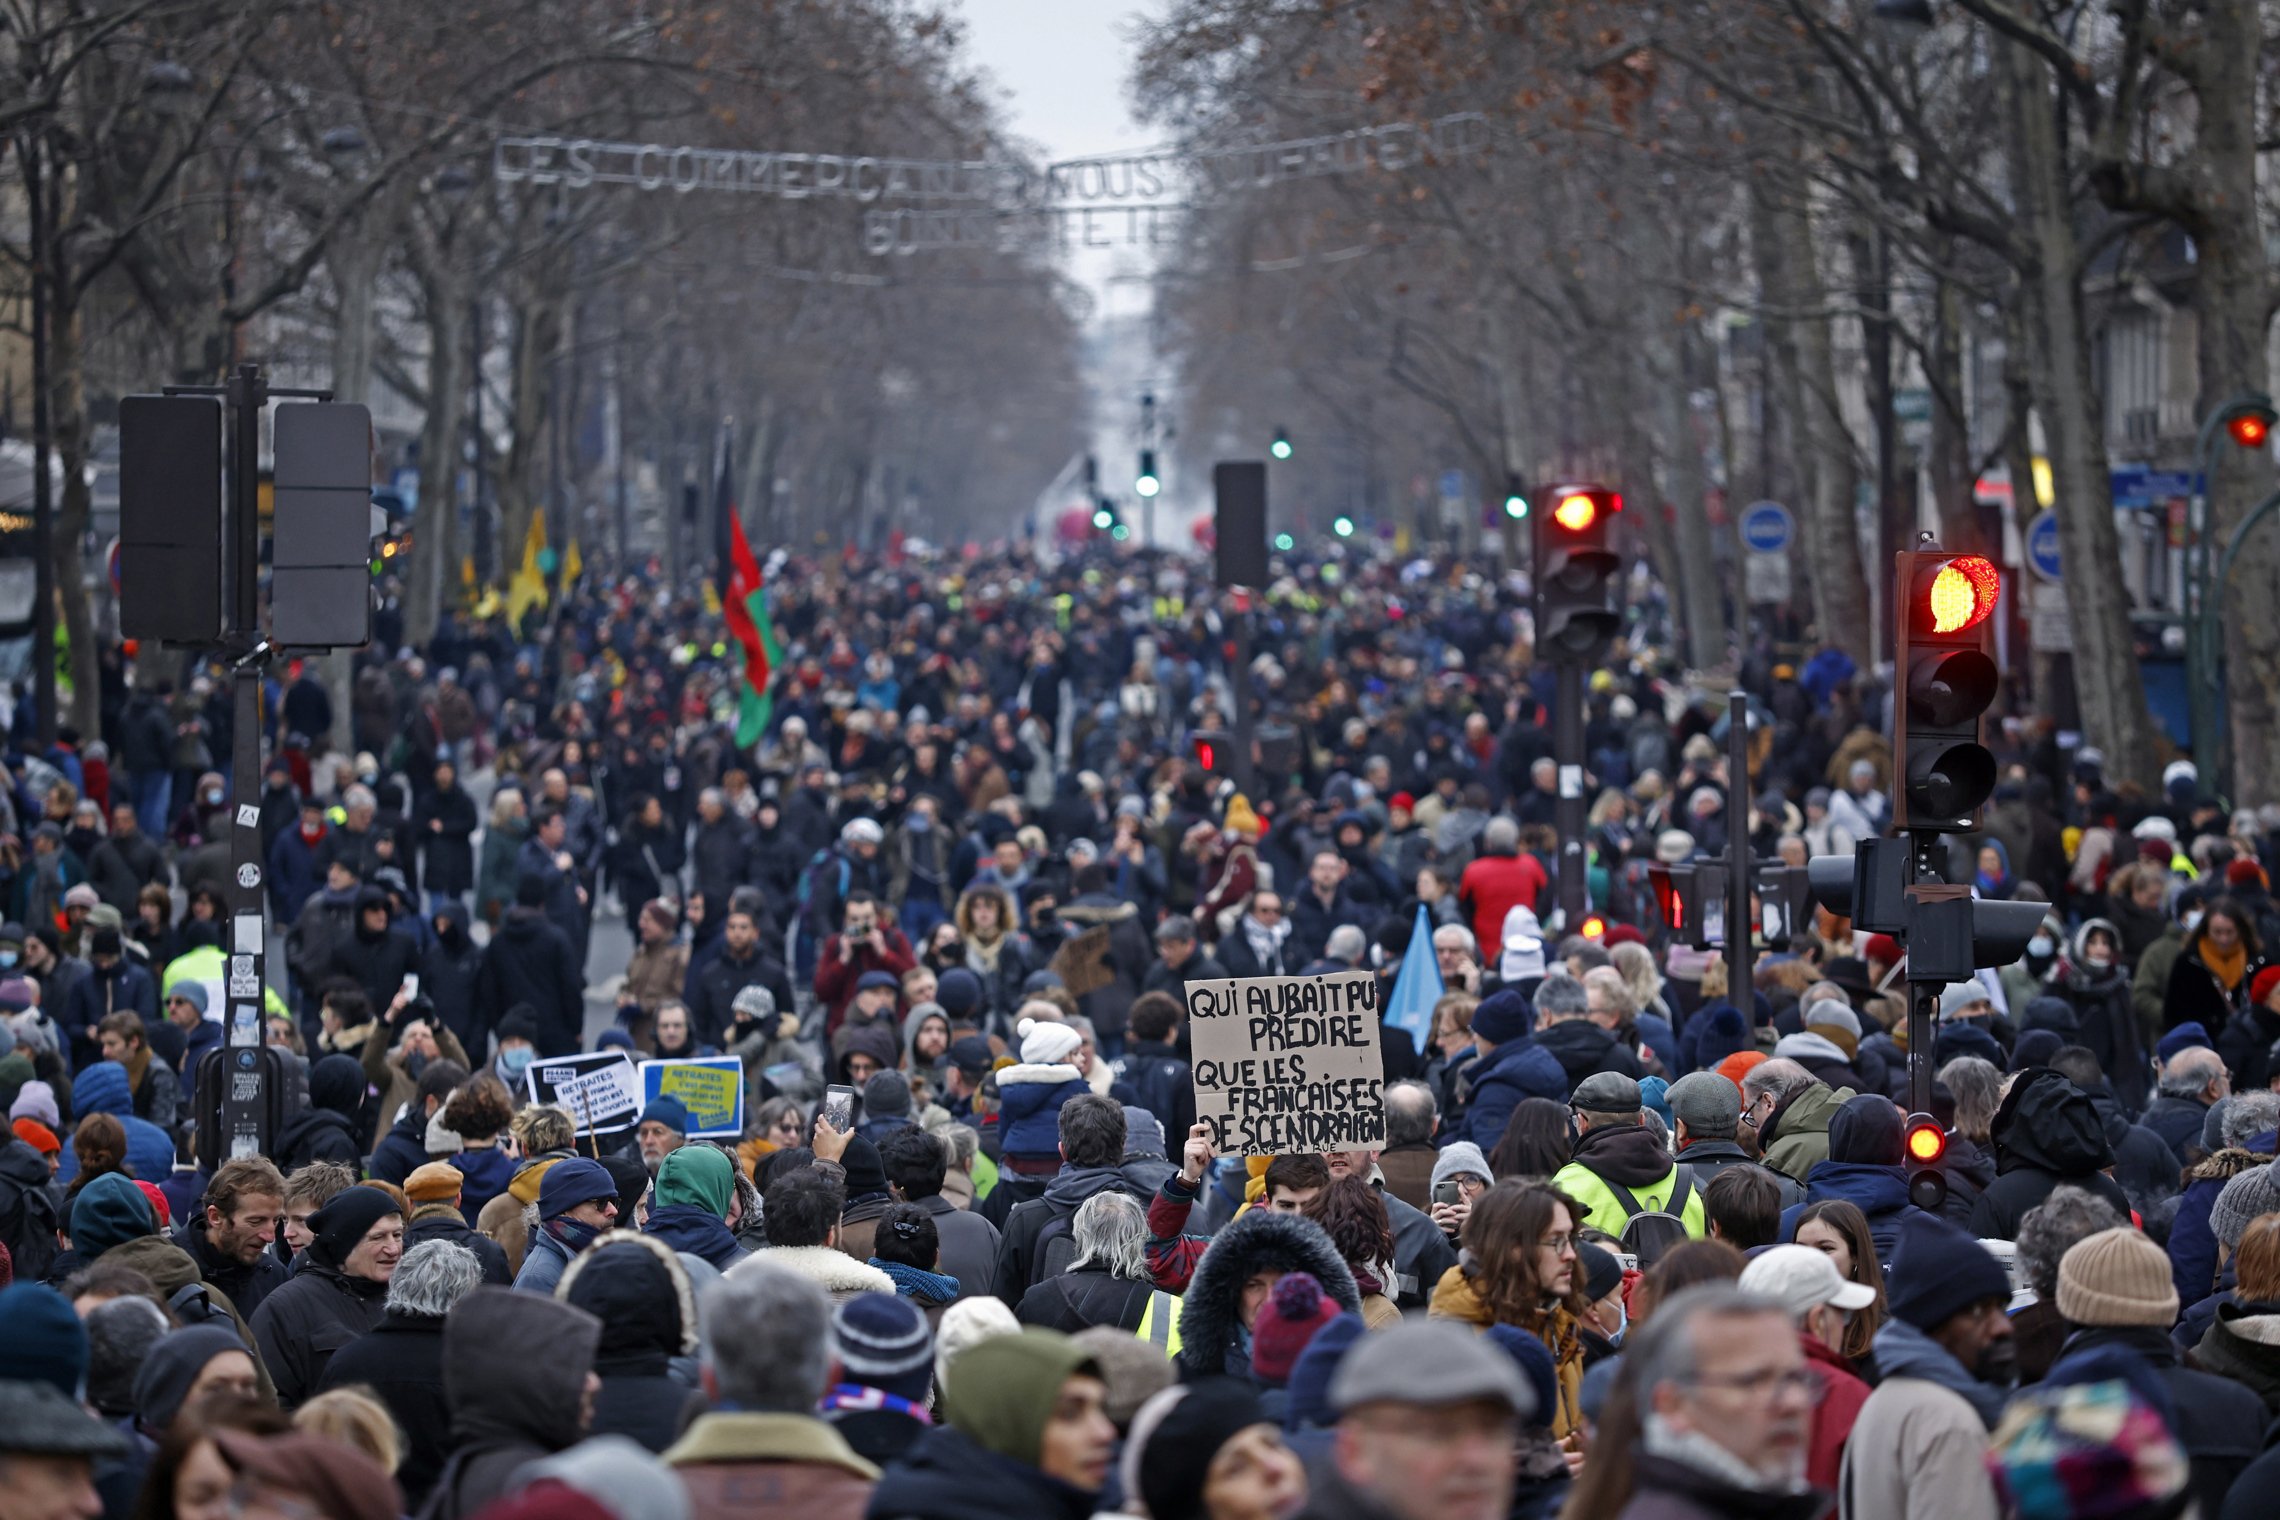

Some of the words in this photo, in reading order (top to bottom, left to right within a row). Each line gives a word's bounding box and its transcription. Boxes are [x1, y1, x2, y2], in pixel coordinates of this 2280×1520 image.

[1346, 980, 1375, 1012] PU
[561, 1071, 613, 1095] RETRAITES
[1195, 1059, 1256, 1090] QUE
[1263, 1054, 1306, 1085] LES
[1241, 1145, 1276, 1157] DANS
[1313, 1143, 1337, 1153] RUE
